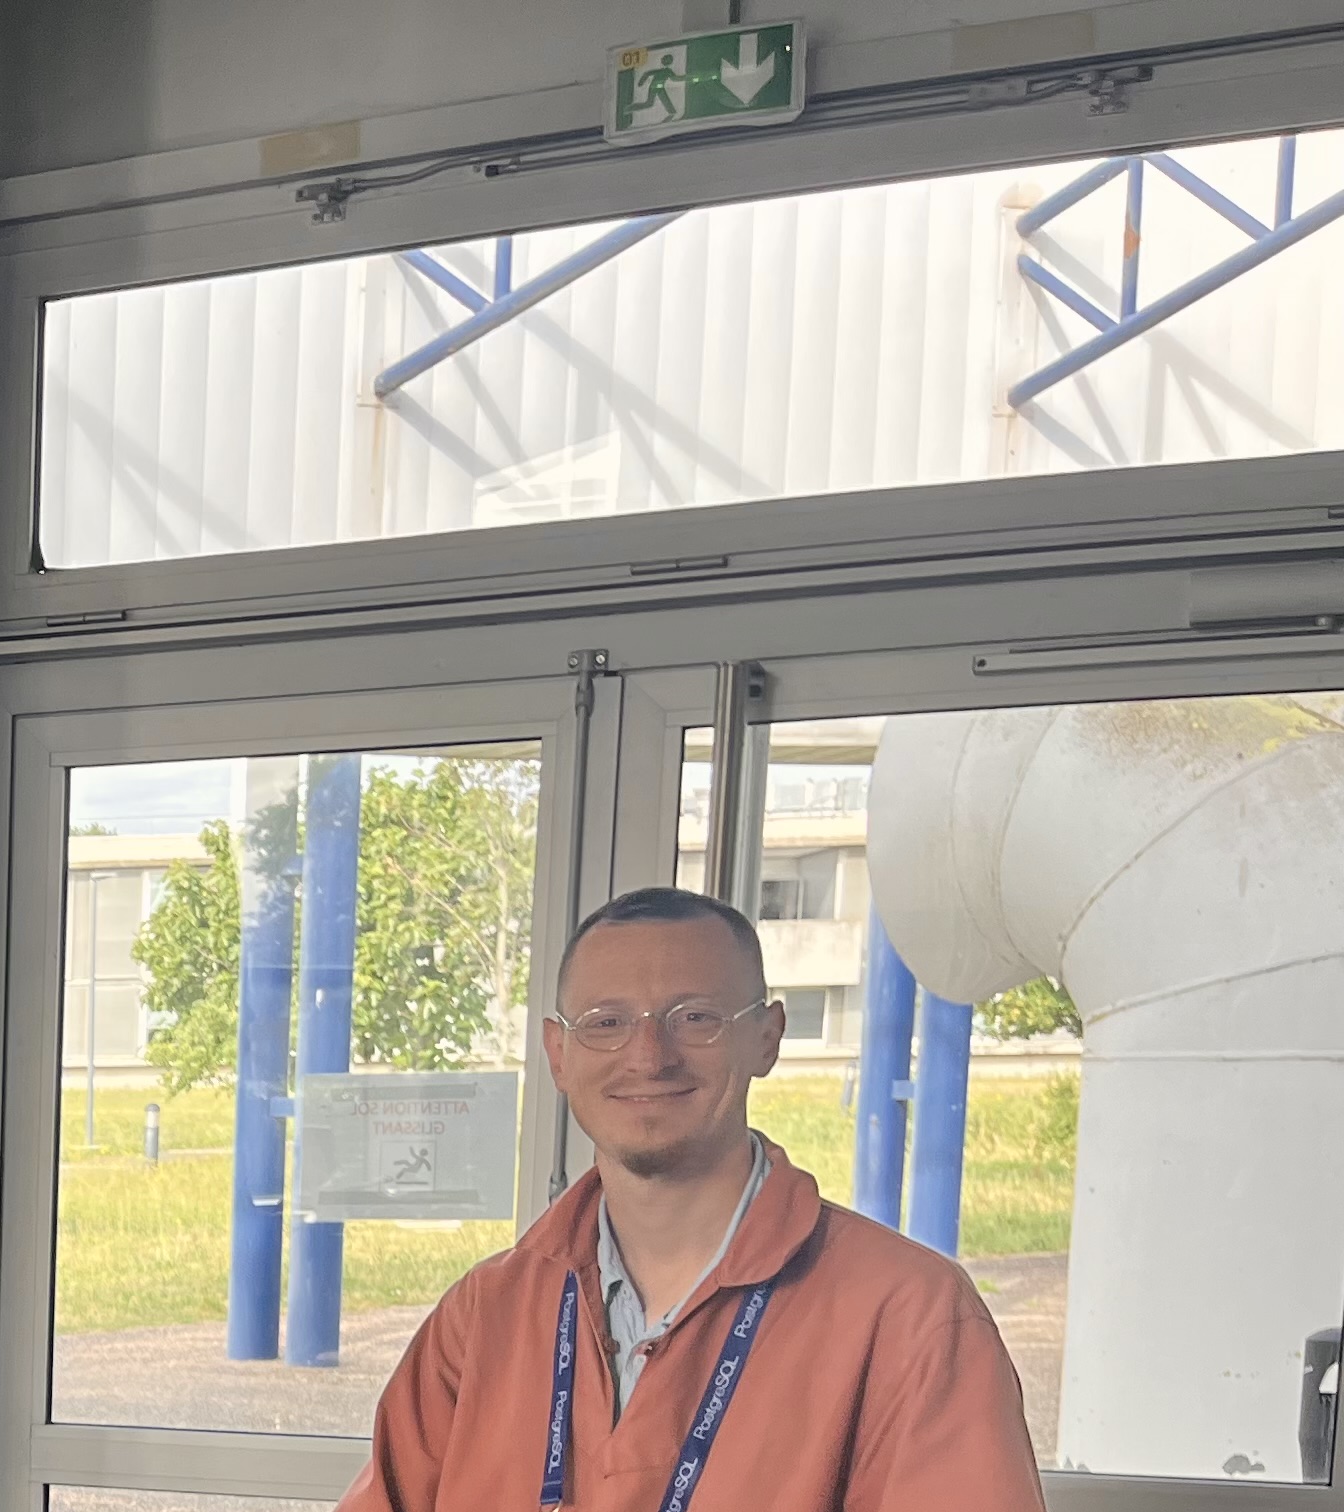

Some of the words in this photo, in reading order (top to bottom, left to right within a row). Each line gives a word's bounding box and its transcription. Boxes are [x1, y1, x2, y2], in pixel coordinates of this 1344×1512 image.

[556, 1291, 576, 1376] PostgreSQL
[547, 1390, 568, 1475] PostgreSQL
[692, 1355, 739, 1440] PostgreSQL
